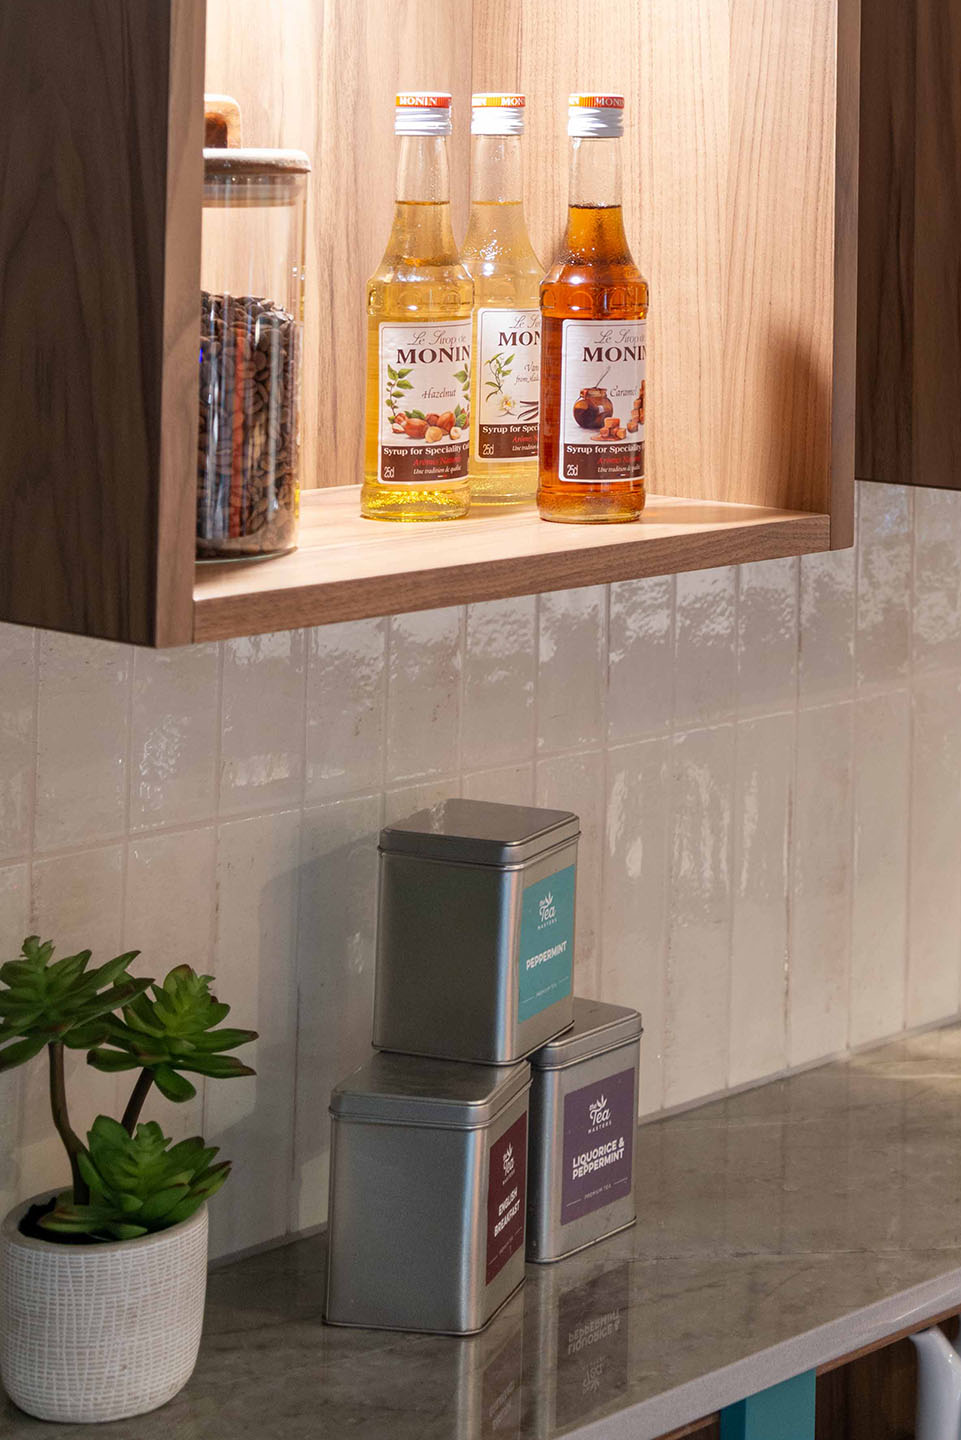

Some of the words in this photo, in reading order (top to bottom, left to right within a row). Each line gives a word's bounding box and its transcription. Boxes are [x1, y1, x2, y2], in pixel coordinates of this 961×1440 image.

[399, 95, 437, 106] MONIN
[406, 330, 427, 346] Le
[593, 329, 613, 344] Le
[396, 344, 471, 365] MONIN
[421, 387, 457, 400] Hazelnut
[609, 385, 638, 398] Caramel
[482, 425, 508, 435] Syrup
[510, 425, 521, 433] for
[383, 446, 408, 457] Syrup
[410, 446, 423, 456] for
[424, 444, 461, 457] Speciality
[566, 445, 592, 456] Syrup
[594, 445, 607, 455] for
[608, 442, 642, 456] Speciality
[539, 904, 556, 922] Tea
[526, 940, 568, 971] PEPPERMINT
[589, 1107, 611, 1127] Tea
[588, 1120, 612, 1135] MASTERS
[572, 1140, 617, 1169] LIQUORICE
[618, 1136, 625, 1149] &
[572, 1147, 625, 1180] PEPPERMINT
[584, 1186, 603, 1200] PREMIUM
[603, 1182, 612, 1192] TEA
[498, 1185, 518, 1218] ENGLISH
[493, 1198, 521, 1238] BREAKFAST
